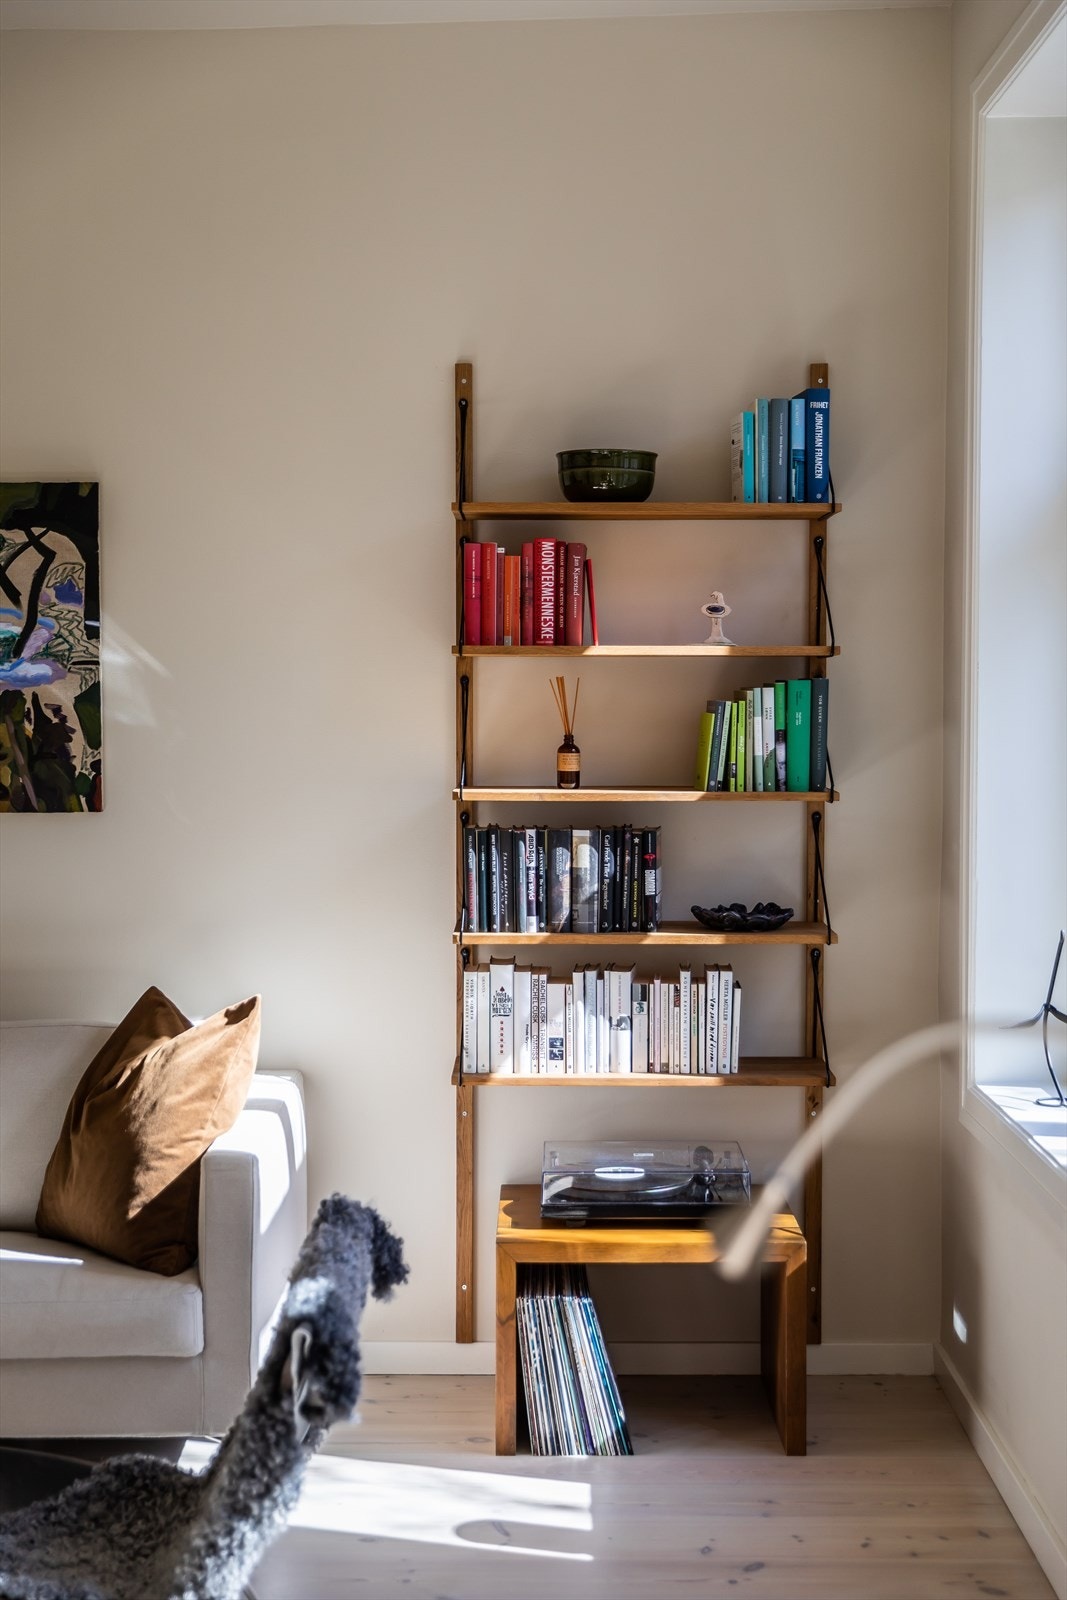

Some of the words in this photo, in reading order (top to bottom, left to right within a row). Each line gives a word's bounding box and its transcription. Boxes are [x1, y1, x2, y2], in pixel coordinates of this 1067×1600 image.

[810, 401, 828, 409] FRIHET
[814, 412, 824, 448] JONATHAN
[814, 448, 824, 479] FRANZEN
[541, 541, 554, 639] MONSTERMENNESKE
[573, 567, 581, 596] Kjærstad
[644, 869, 656, 896] GOMORRA
